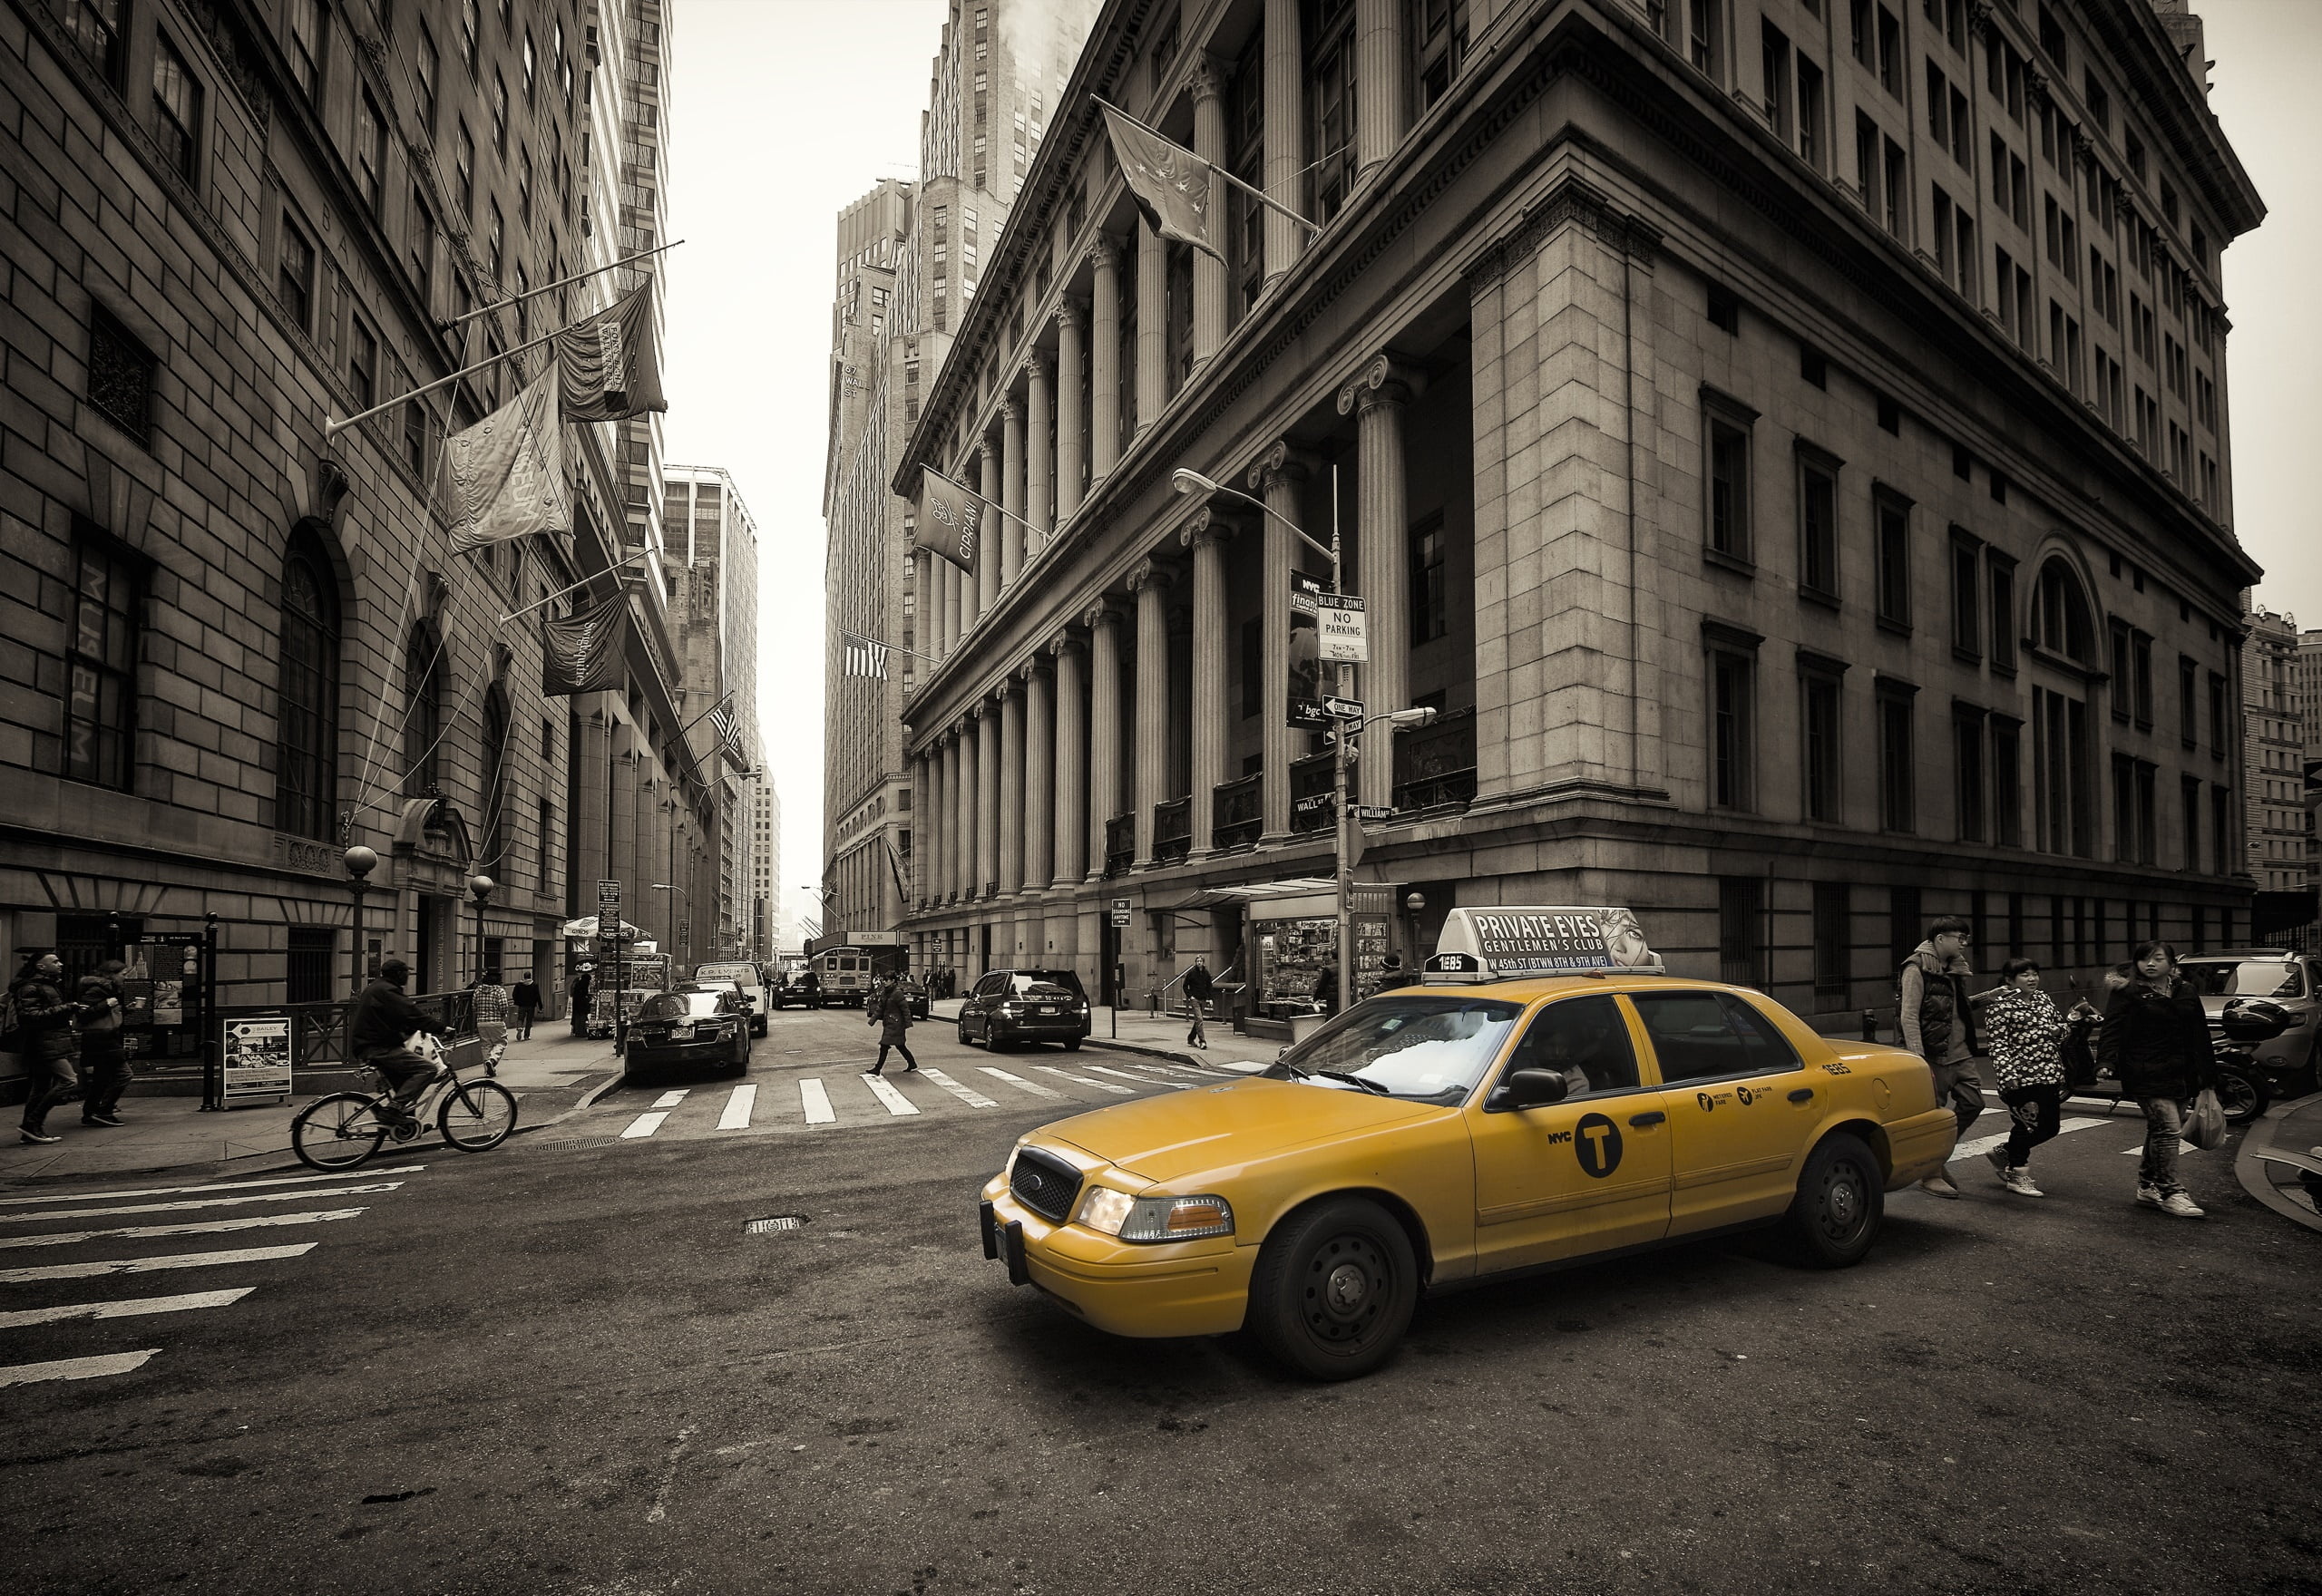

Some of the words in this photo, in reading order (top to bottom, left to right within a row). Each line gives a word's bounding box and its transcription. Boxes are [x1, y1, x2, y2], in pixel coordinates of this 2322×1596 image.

[601, 326, 611, 353] WALL
[959, 500, 977, 560] CIPRIANI
[1318, 596, 1340, 608] BLUE
[1343, 598, 1364, 610] ZONE
[1333, 612, 1351, 624] NO
[1325, 624, 1361, 636] PARKING
[573, 622, 597, 686] SwigEquities
[1306, 704, 1321, 718] bgc
[1334, 703, 1346, 712] ONE
[1348, 706, 1361, 716] WAY
[1348, 721, 1361, 732] WAY
[1297, 800, 1319, 813] WALL
[1361, 808, 1386, 819] WILLIAM
[1475, 915, 1556, 939] PRIVATE
[1556, 913, 1600, 938] EYES
[1484, 939, 1570, 953] GENTLEMEN'S
[1574, 939, 1605, 951] CLUB
[1488, 959, 1498, 970] W
[1498, 958, 1517, 970] 45th
[1517, 958, 1527, 968] ST
[1527, 957, 1554, 970] (BTWN
[1554, 956, 1569, 968] 8TH
[1569, 957, 1576, 967] &
[1576, 956, 1591, 968] 9TH
[1592, 955, 1608, 968] AVE)
[1547, 1131, 1572, 1144] NYC
[1584, 1124, 1611, 1171] T
